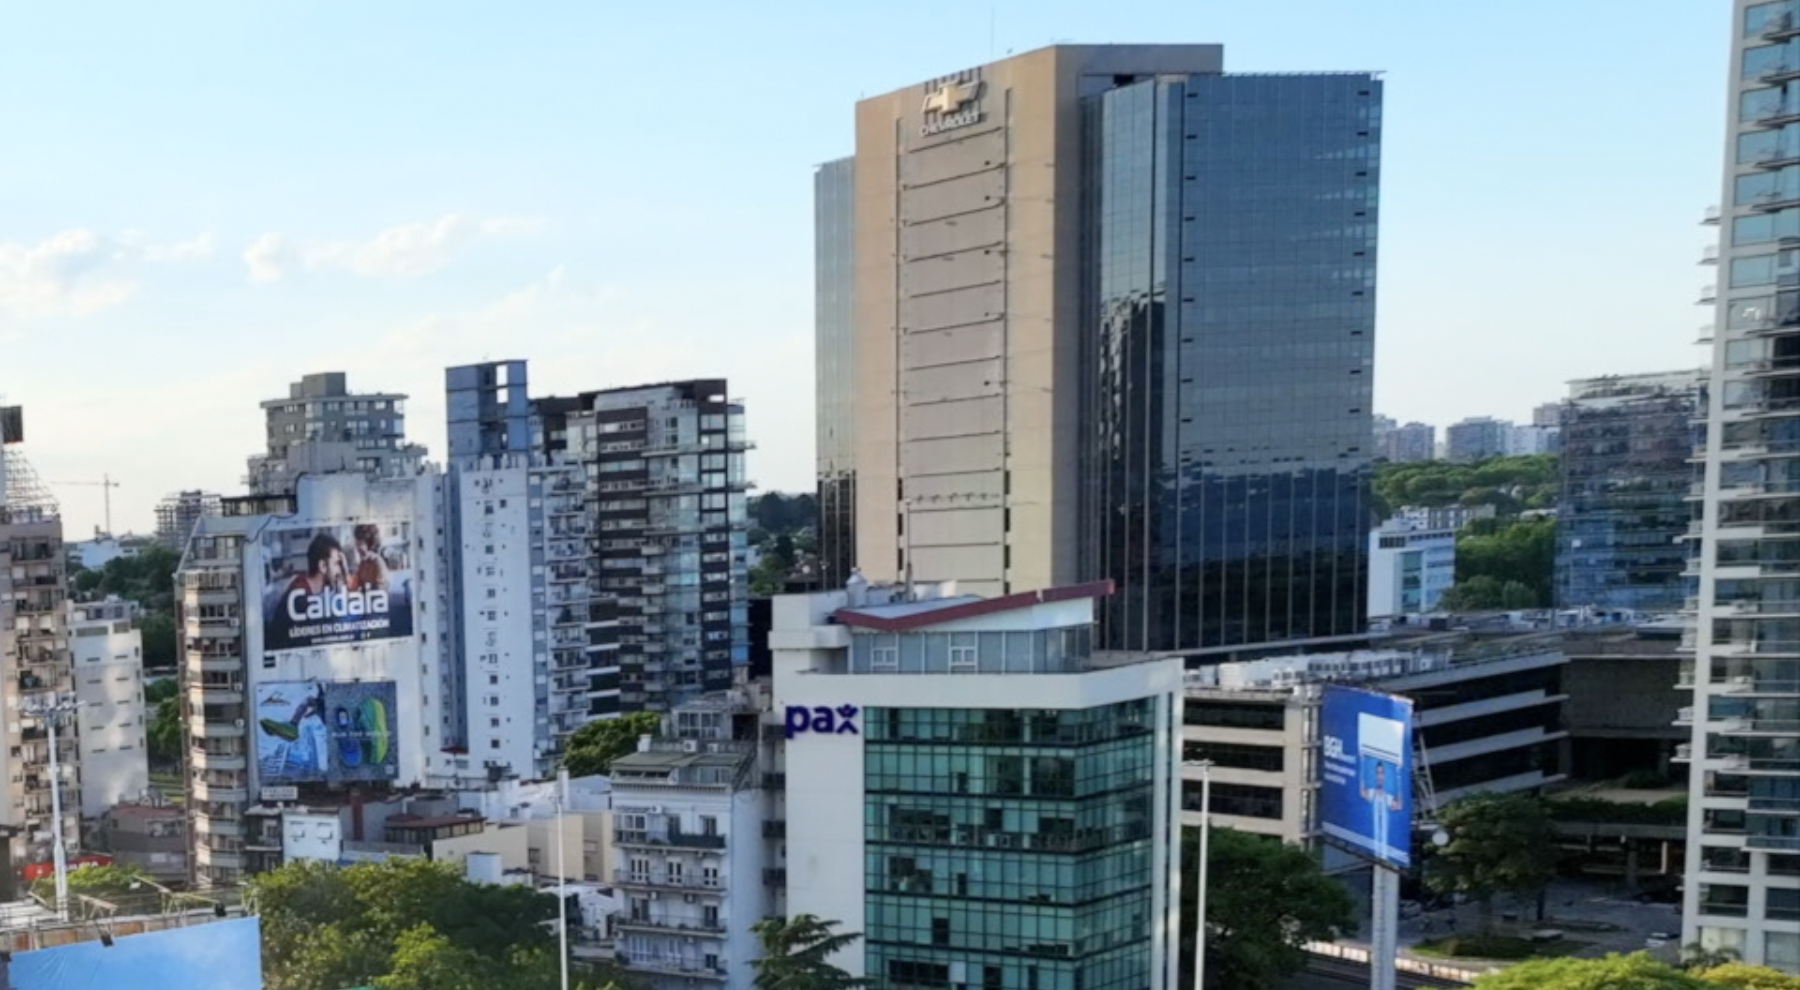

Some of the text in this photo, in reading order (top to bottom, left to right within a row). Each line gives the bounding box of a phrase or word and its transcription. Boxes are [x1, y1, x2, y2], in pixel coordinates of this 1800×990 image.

[287, 583, 389, 621] Caldaia
[322, 623, 333, 633] EN
[785, 704, 859, 739] pax
